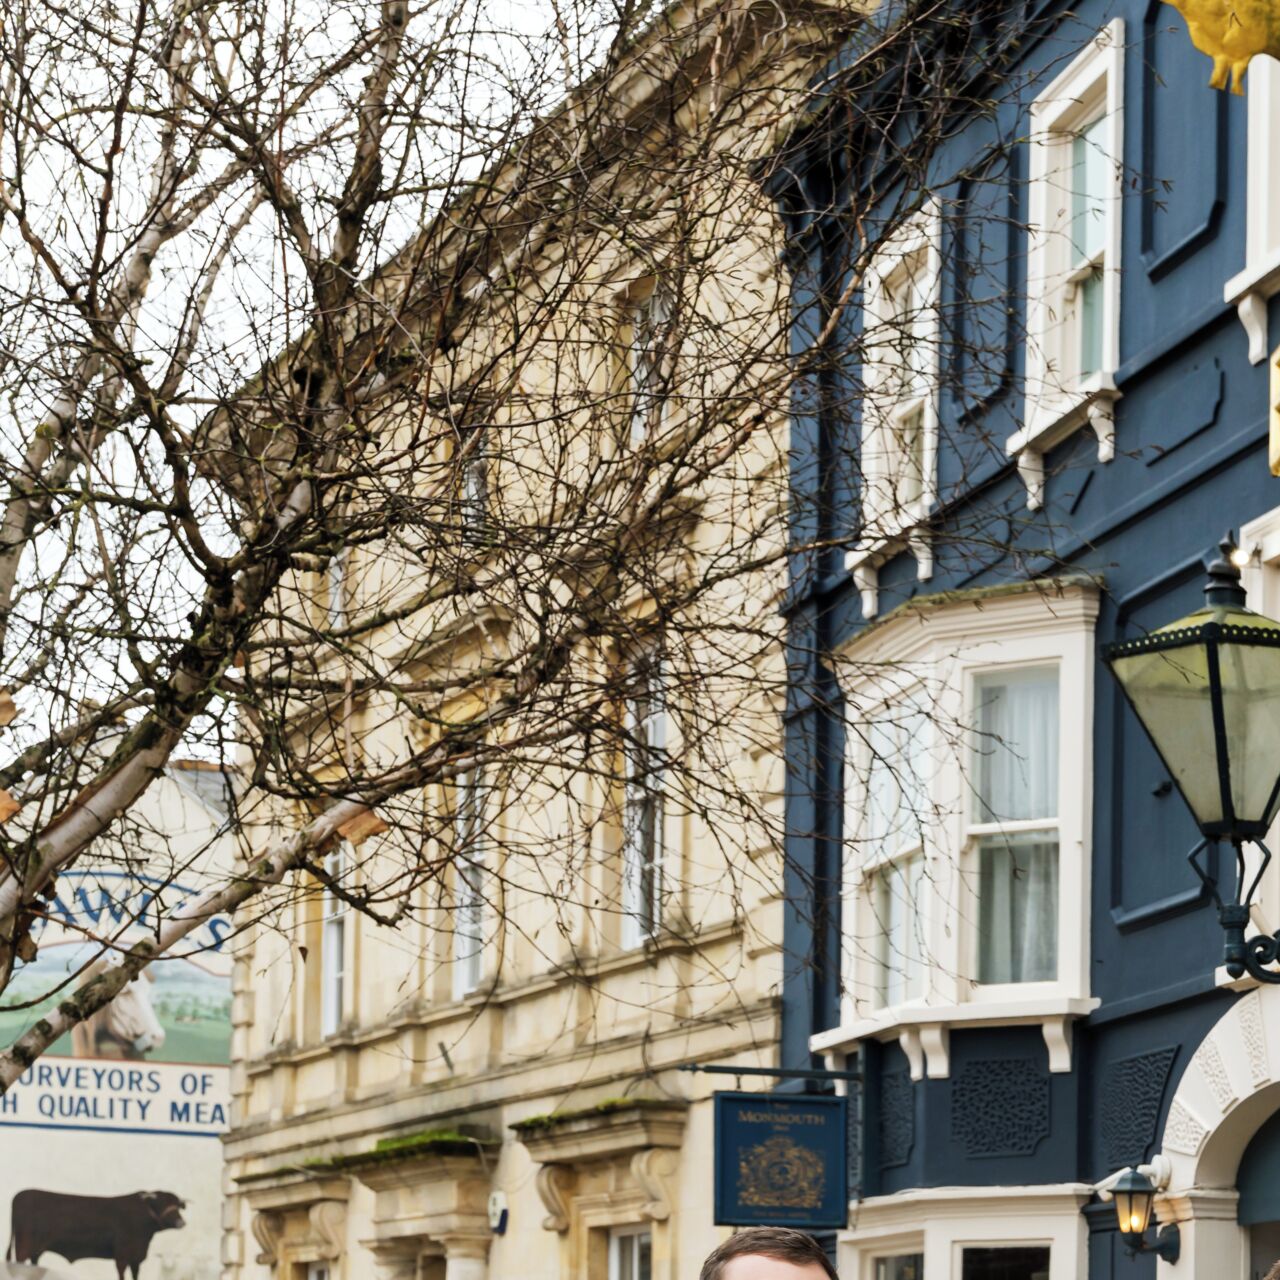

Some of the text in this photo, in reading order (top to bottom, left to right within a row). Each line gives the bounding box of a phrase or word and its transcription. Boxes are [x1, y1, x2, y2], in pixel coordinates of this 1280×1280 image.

[19, 1065, 213, 1095] URVEYORS OF
[39, 1094, 150, 1121] QUALITY
[170, 1101, 226, 1124] MEA
